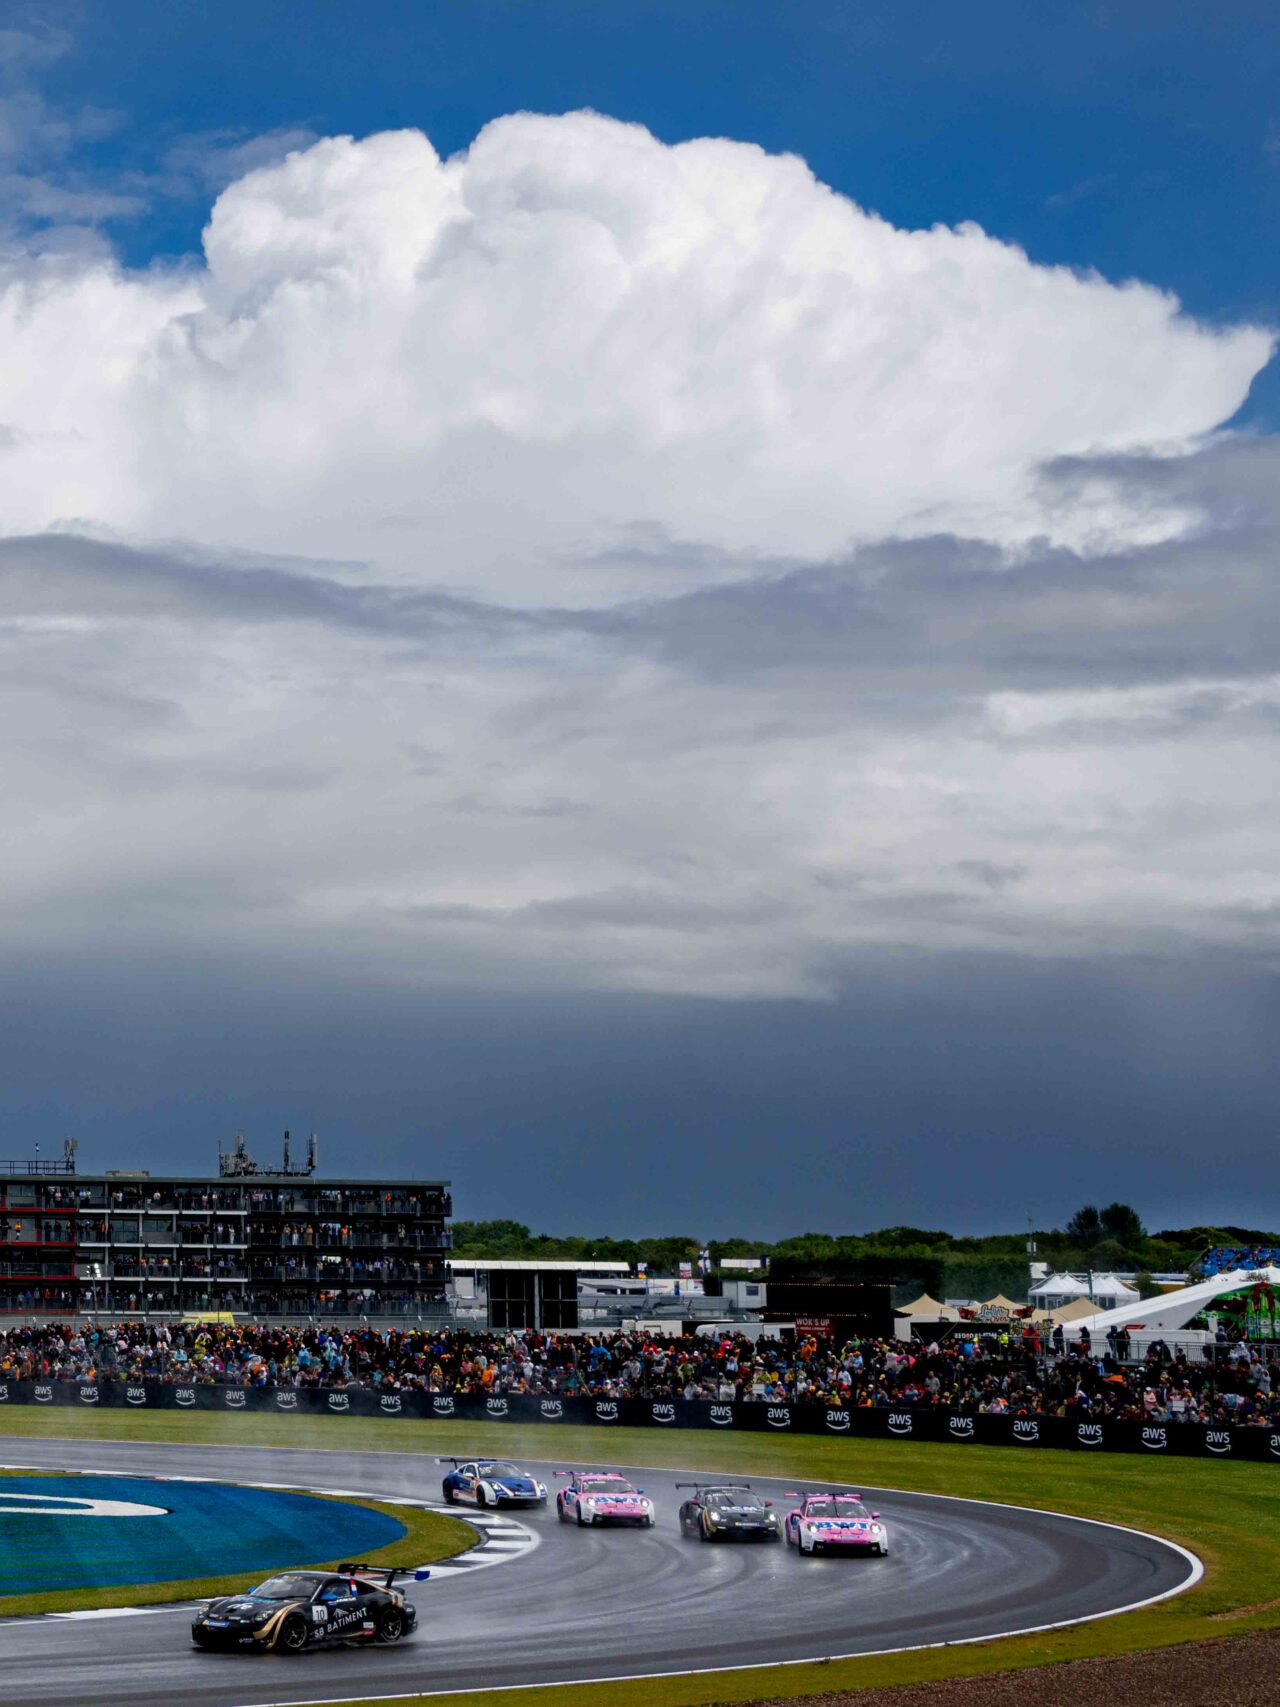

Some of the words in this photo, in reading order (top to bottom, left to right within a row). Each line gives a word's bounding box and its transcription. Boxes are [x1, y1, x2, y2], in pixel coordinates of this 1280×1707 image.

[820, 1318, 830, 1327] UP
[35, 1386, 51, 1394] aws
[81, 1387, 98, 1395] aws
[127, 1388, 145, 1397] aws
[176, 1390, 194, 1398] aws
[226, 1391, 245, 1400] aws
[277, 1393, 296, 1401] aws
[329, 1394, 348, 1403] aws
[381, 1395, 400, 1405] aws
[434, 1397, 453, 1406] aws
[487, 1399, 507, 1408] aws
[541, 1400, 561, 1410] aws
[596, 1402, 617, 1412] aws
[653, 1404, 674, 1414] aws
[711, 1406, 731, 1416] aws
[768, 1408, 789, 1418] aws
[827, 1411, 849, 1422] aws
[889, 1414, 911, 1425] aws
[950, 1417, 973, 1428] aws
[1014, 1421, 1038, 1432] aws
[1078, 1424, 1102, 1435] aws
[1142, 1427, 1166, 1439] aws
[1206, 1431, 1230, 1443] aws
[816, 1522, 868, 1530] BWT
[315, 1610, 325, 1620] 10
[327, 1607, 367, 1633] BATIMENT
